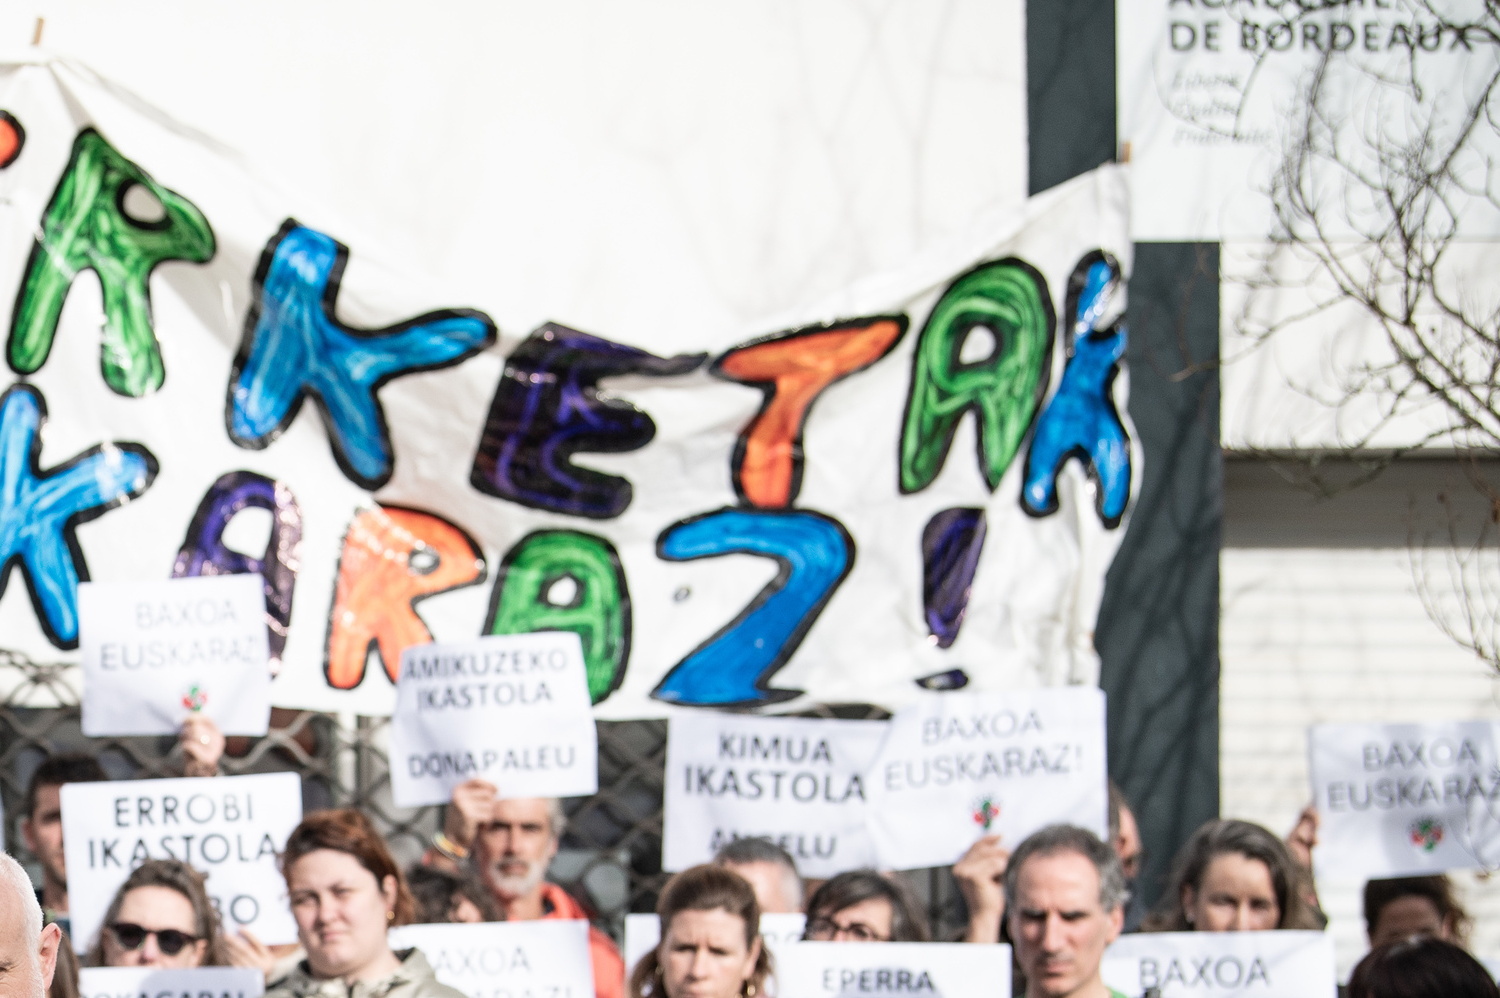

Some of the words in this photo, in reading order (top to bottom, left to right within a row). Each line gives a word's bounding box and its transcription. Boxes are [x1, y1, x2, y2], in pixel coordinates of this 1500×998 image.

[1171, 22, 1220, 50] DE
[1241, 22, 1474, 50] BORDEAUX
[136, 599, 238, 628] BAXOA
[404, 647, 567, 682] AMIKUZEKO
[417, 681, 552, 710] IKASTOLA
[923, 709, 1043, 744] BAXOA
[409, 745, 575, 779] DONAPALEU
[718, 732, 833, 764] KIMUA
[1363, 738, 1480, 771] BAXOA
[684, 767, 867, 801] IKASTOLA
[885, 746, 1082, 789] EUSKARAZ!
[114, 794, 254, 827] ERROBI
[88, 832, 277, 868] IKASTOLA
[823, 968, 937, 992] EPERRA
[1140, 955, 1270, 989] BAXOA
